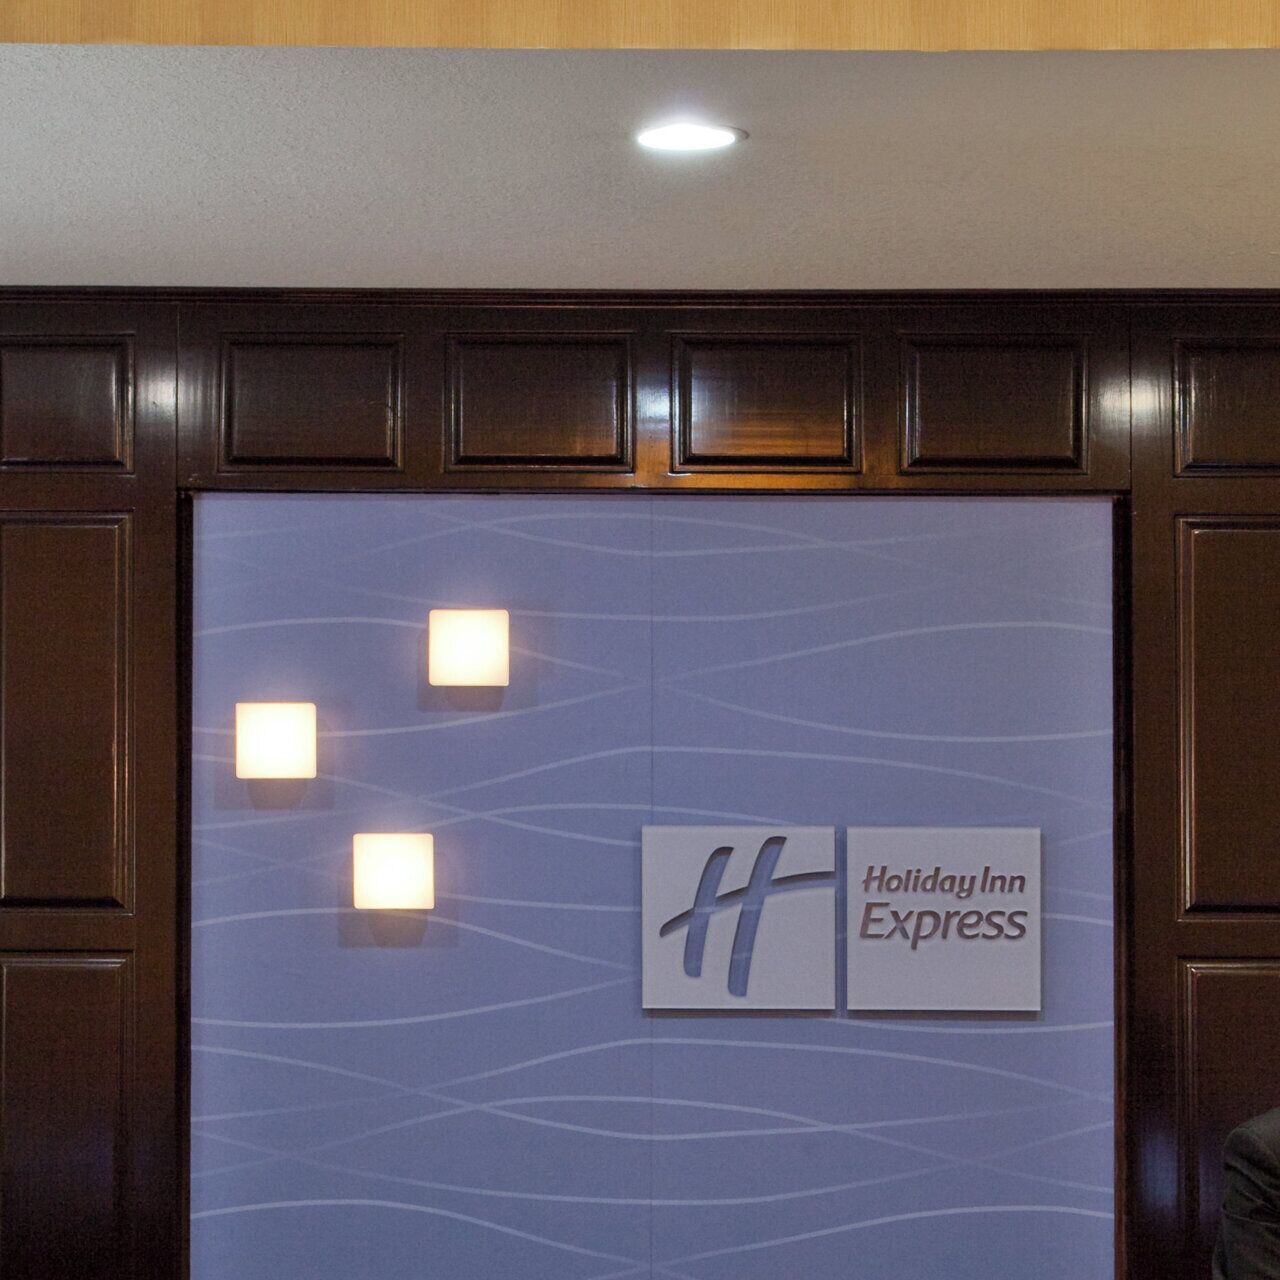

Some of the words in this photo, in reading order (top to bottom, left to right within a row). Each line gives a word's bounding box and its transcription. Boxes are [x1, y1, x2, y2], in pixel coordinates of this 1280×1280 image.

[862, 865, 977, 899] Holiday
[980, 866, 1026, 893] Inn
[859, 902, 1028, 950] Express
